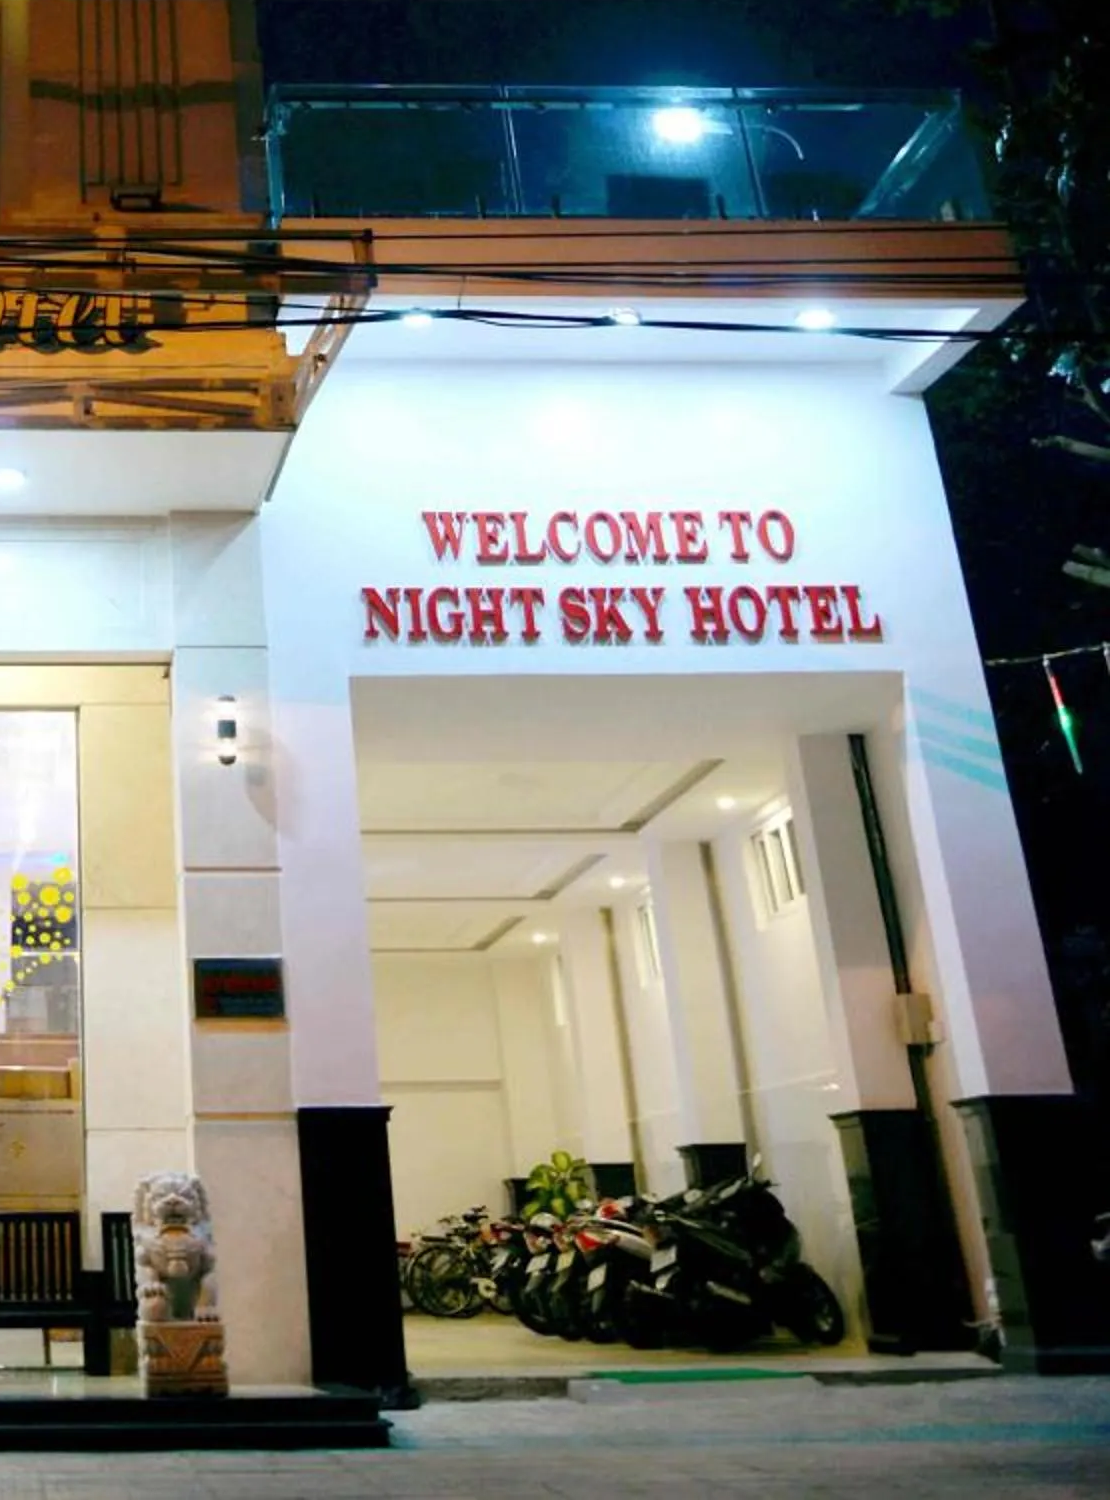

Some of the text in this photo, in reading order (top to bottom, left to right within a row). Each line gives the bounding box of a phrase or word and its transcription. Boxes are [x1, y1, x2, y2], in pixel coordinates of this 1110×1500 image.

[421, 510, 796, 564] WELCOME TO
[361, 585, 882, 644] NIGHT SKY HOTEL
